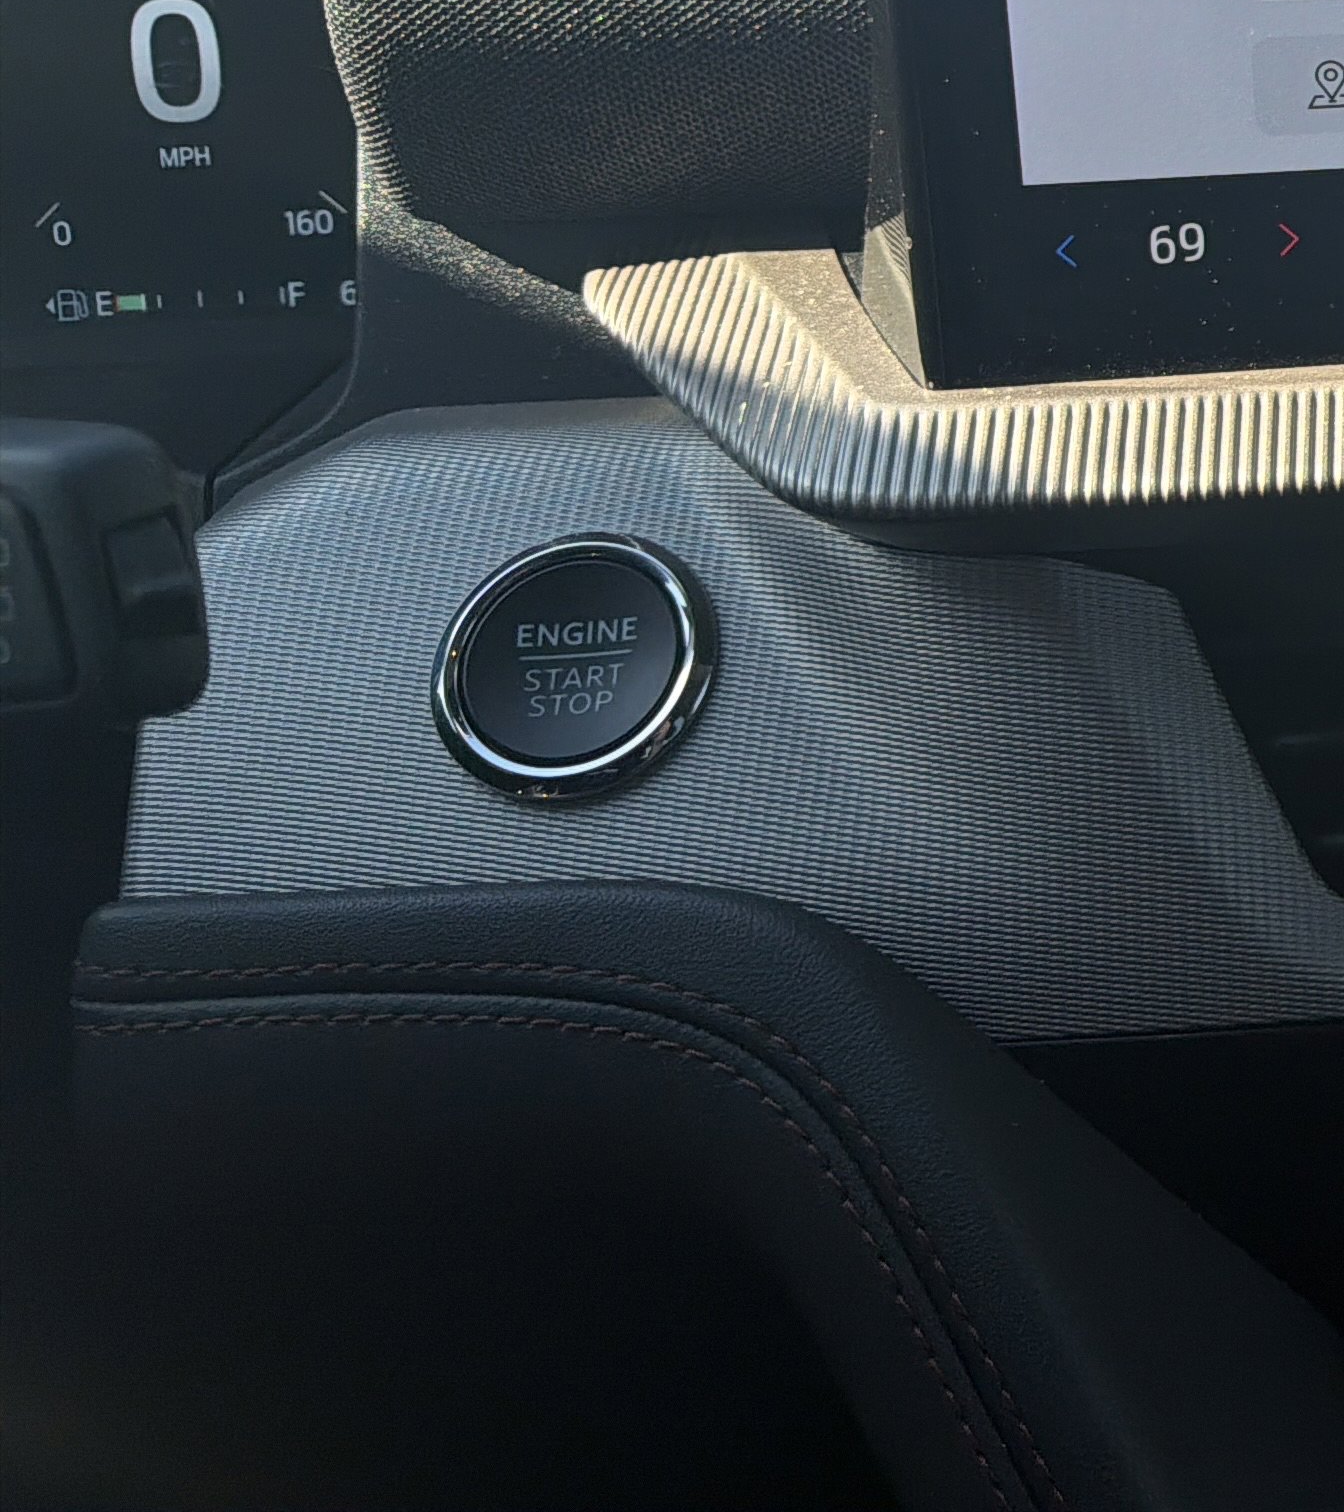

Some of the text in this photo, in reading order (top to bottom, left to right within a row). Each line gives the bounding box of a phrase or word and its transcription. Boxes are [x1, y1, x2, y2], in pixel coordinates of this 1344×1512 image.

[159, 146, 212, 168] MPH
[52, 220, 72, 246] 0
[284, 208, 335, 237] 160
[1148, 222, 1206, 266] 69
[96, 291, 114, 317] E
[287, 281, 306, 307] F
[516, 616, 638, 648] ENGINE
[524, 662, 626, 692] START
[528, 691, 614, 718] STOP
